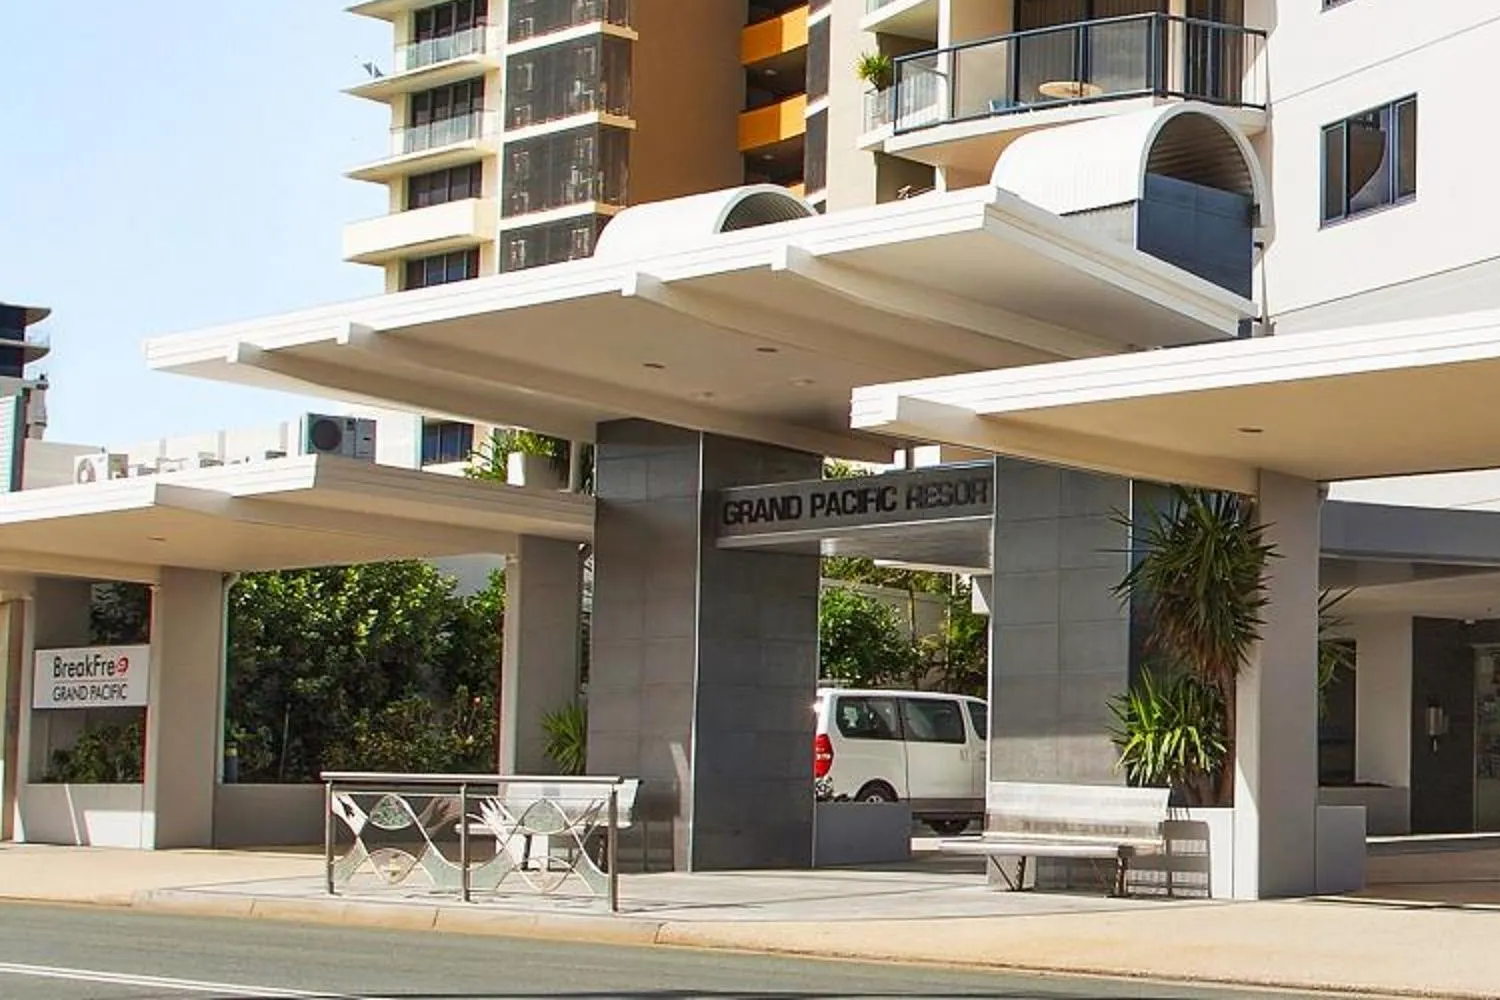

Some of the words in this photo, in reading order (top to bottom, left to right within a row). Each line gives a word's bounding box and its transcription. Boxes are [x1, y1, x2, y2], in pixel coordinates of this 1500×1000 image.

[723, 495, 802, 526] GRAND
[810, 485, 897, 518] PACIFIC
[905, 478, 993, 510] RESOR
[53, 685, 88, 701] GRAND
[90, 683, 128, 700] PACIFIC
